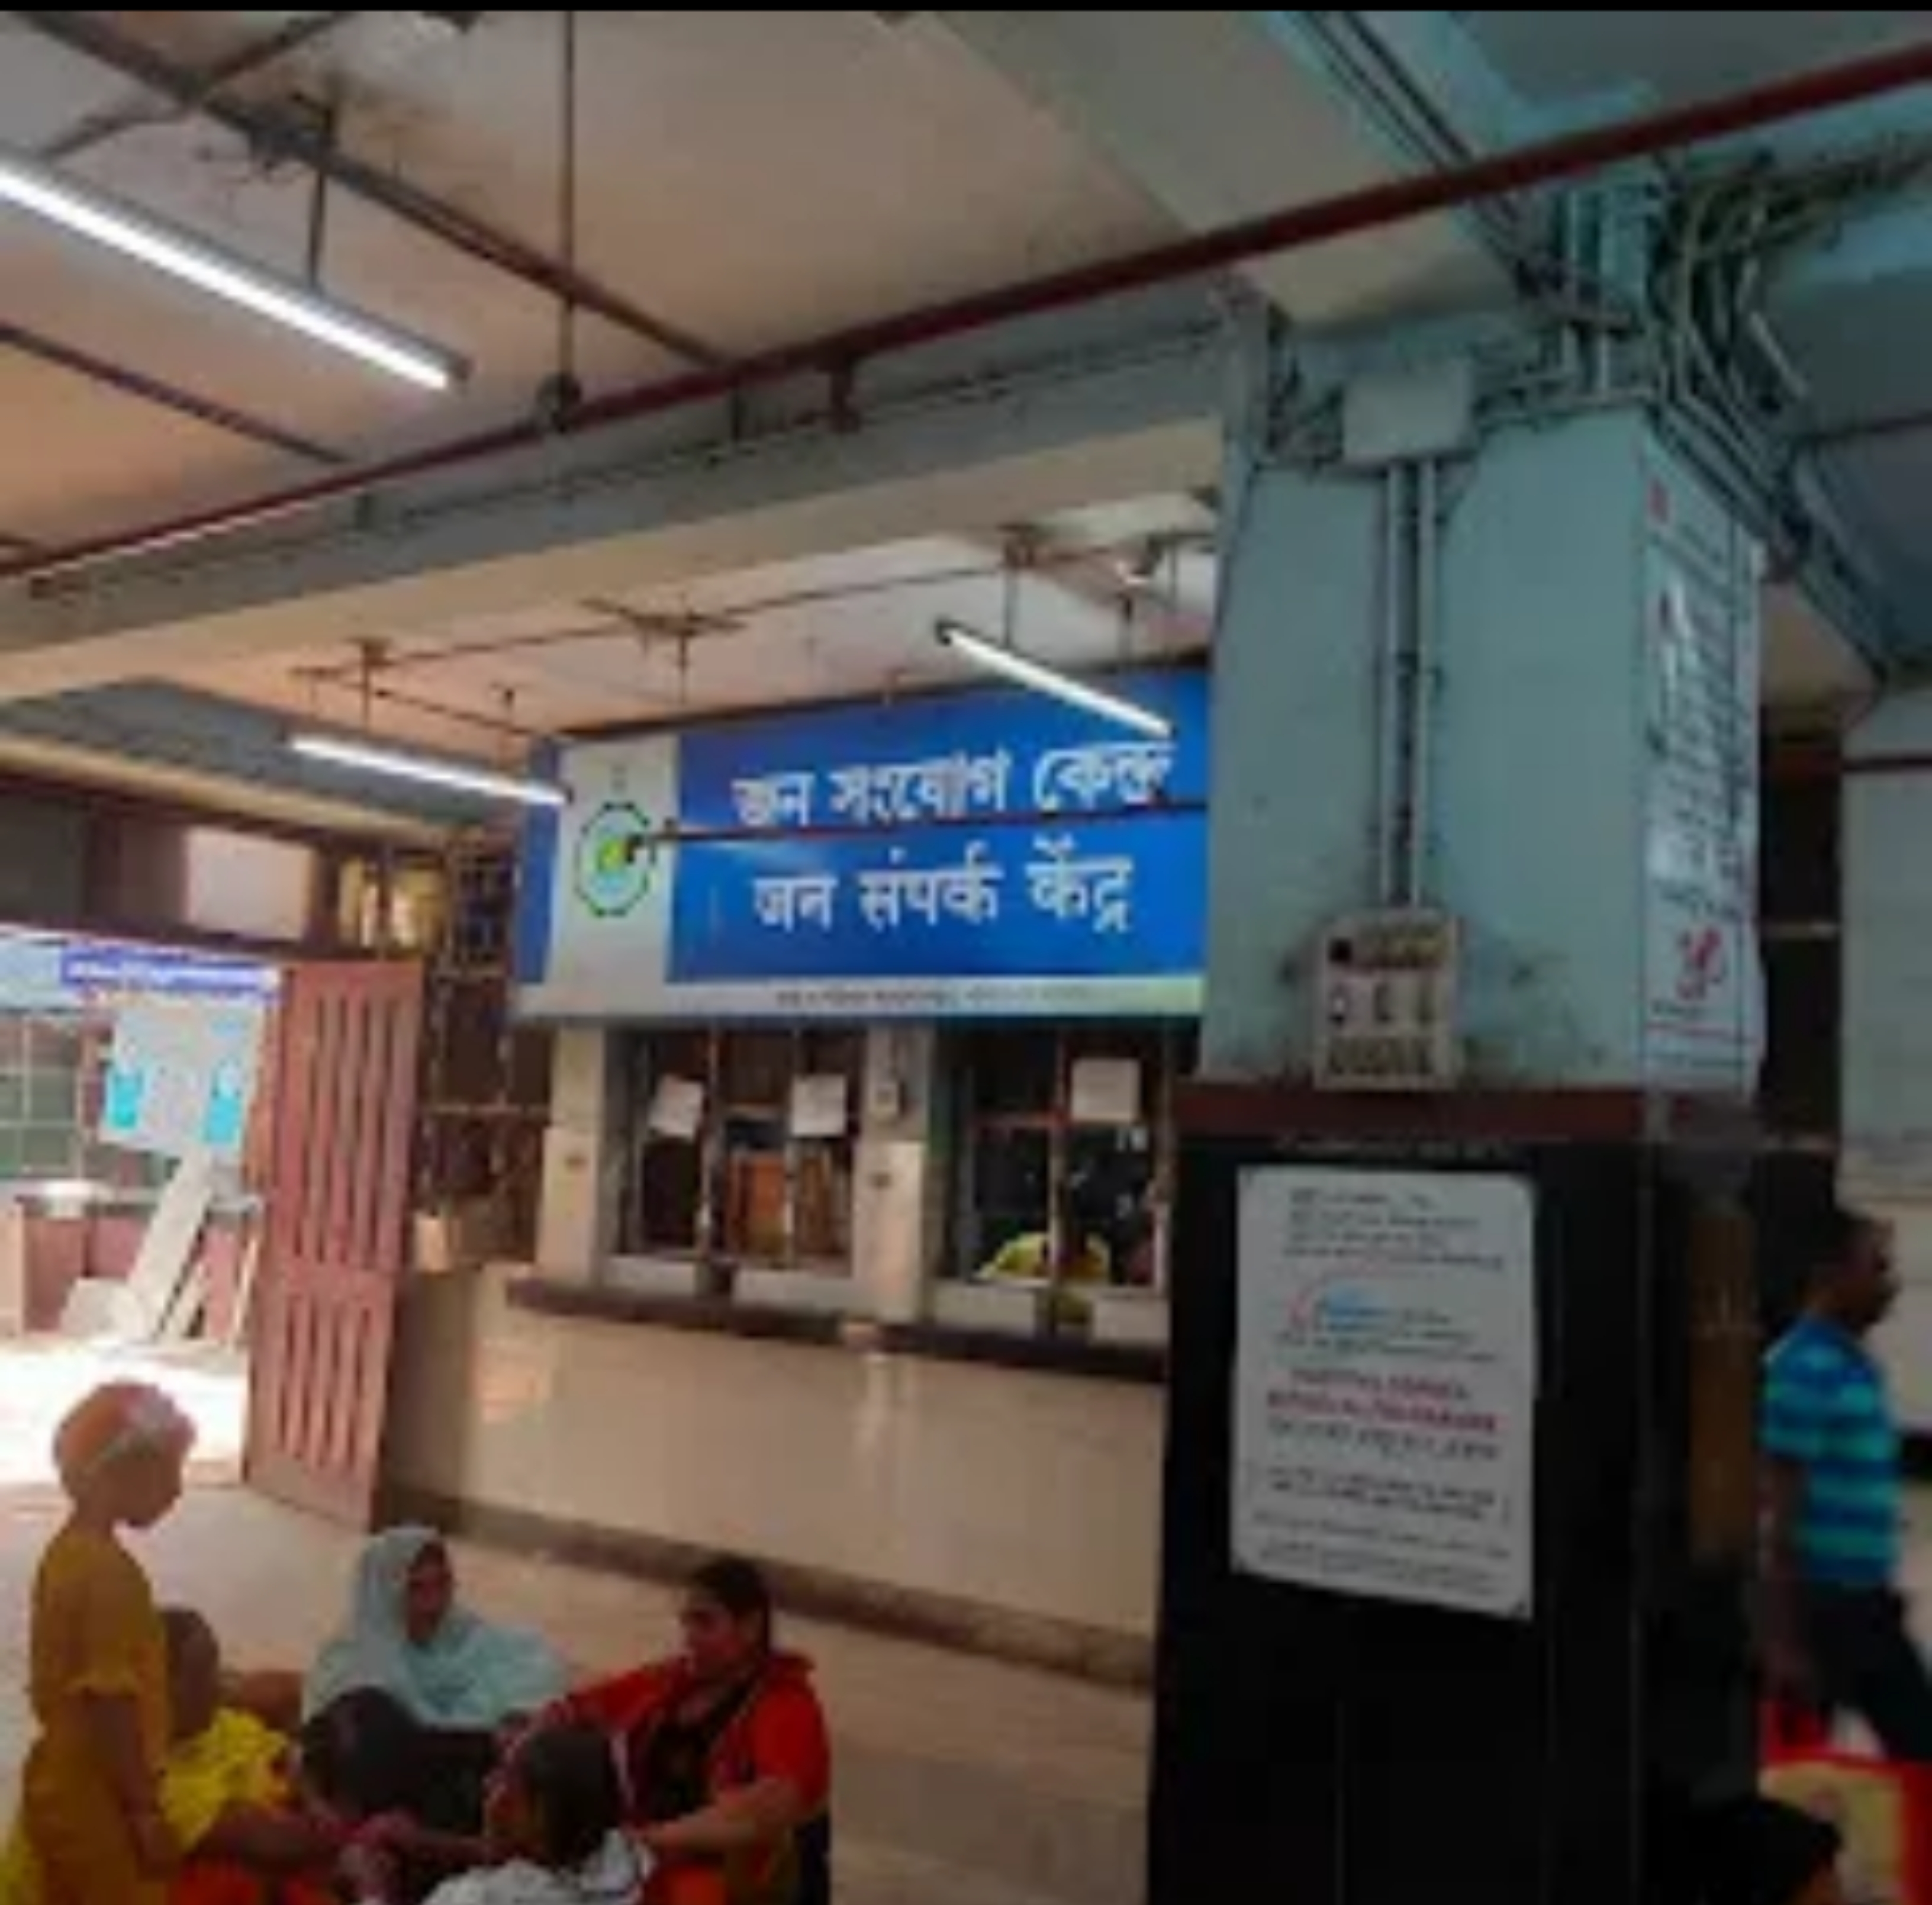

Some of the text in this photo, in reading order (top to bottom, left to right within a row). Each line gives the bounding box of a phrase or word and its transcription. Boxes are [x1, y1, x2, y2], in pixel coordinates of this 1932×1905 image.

[730, 771, 814, 828] জন
[829, 745, 1010, 825] সংযোগ
[753, 832, 1133, 933] जन संपर्क केंद्र
